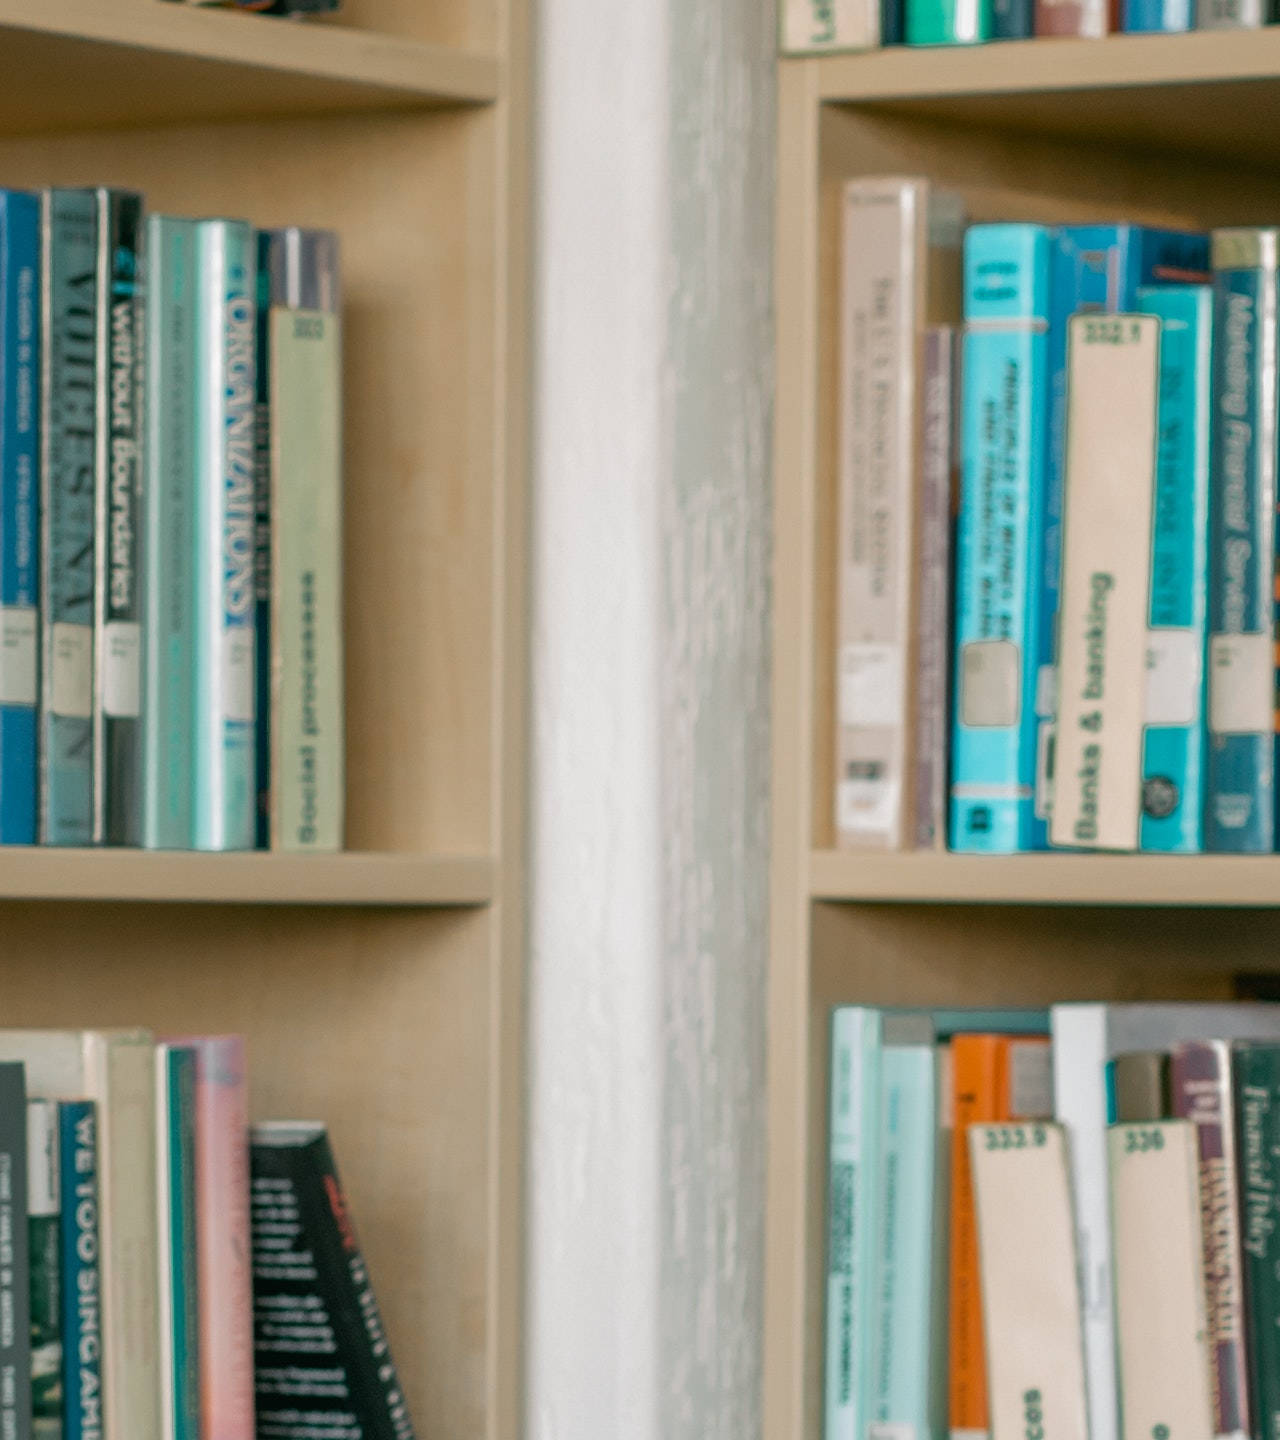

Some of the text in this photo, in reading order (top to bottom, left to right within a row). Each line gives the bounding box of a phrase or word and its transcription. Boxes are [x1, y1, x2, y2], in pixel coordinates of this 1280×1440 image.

[1076, 573, 1115, 839] Banks & banking
